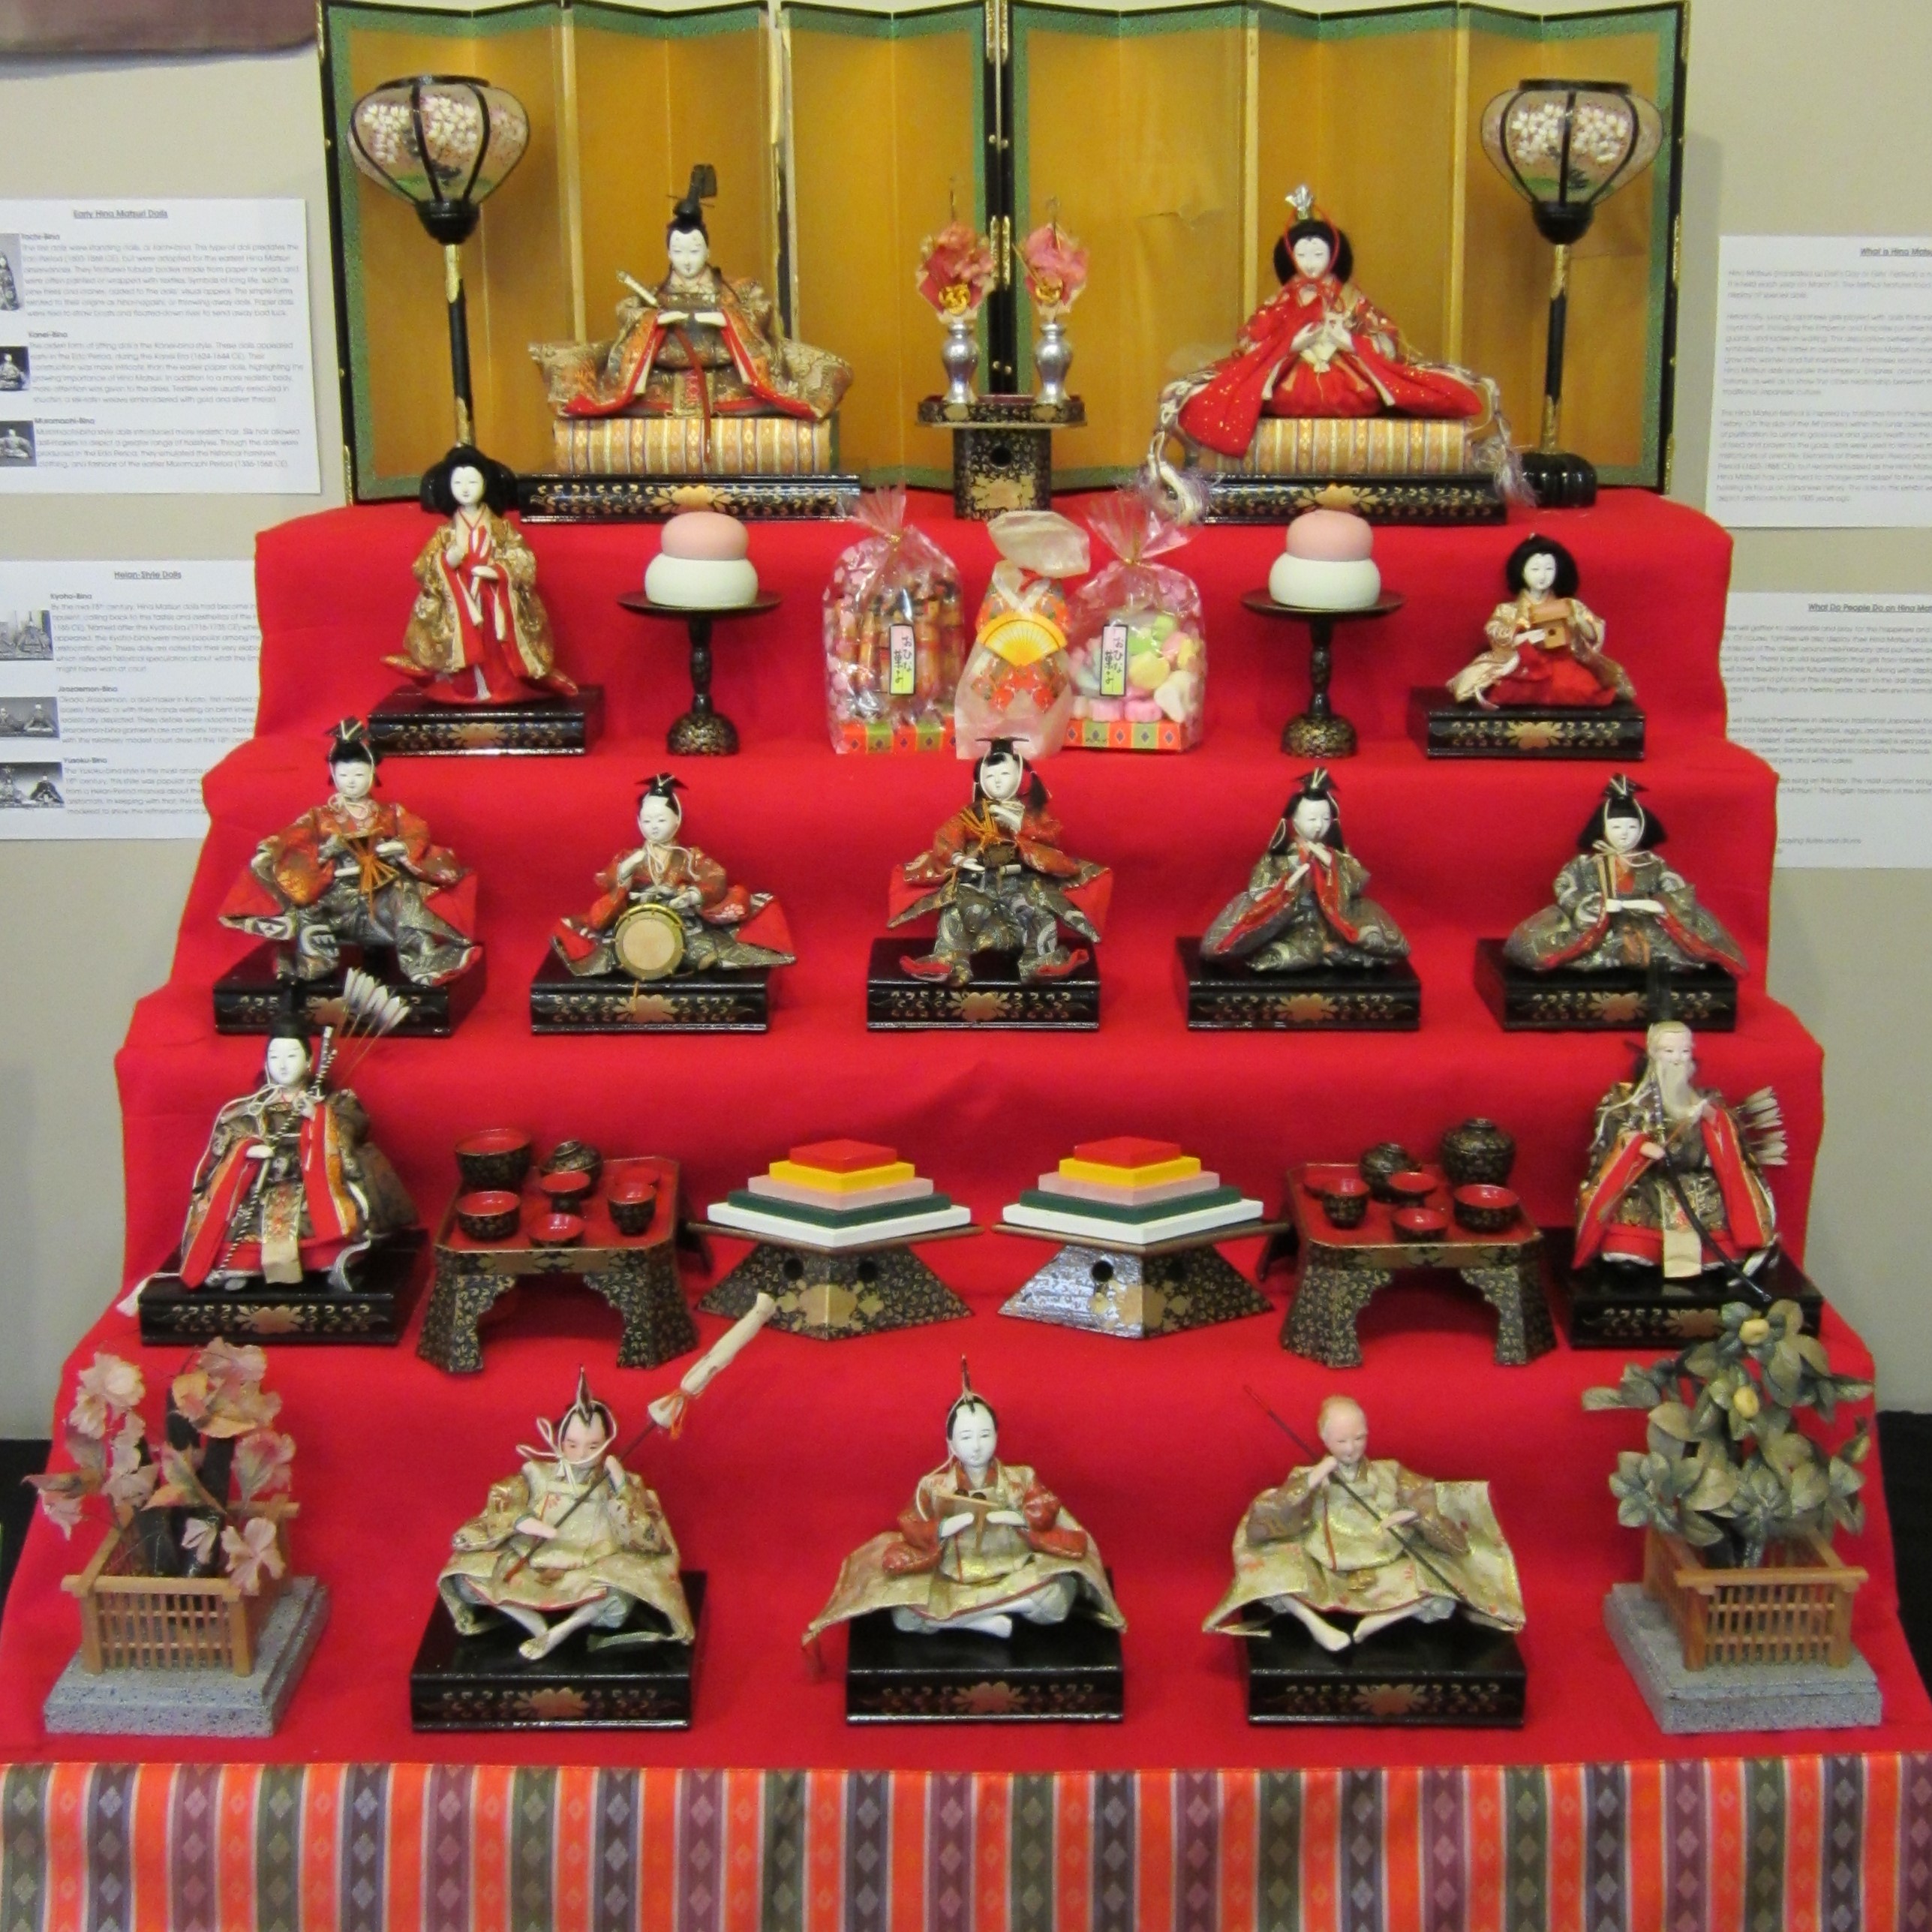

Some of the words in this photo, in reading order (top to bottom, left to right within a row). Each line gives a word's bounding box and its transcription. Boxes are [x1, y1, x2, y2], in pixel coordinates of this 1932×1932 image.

[95, 210, 114, 219] Hina
[116, 210, 146, 219] Matsuri
[115, 571, 159, 579] Heian-Style
[162, 571, 182, 579] Dolls
[1808, 604, 1828, 612] What
[1831, 604, 1841, 612] Do
[1843, 604, 1870, 612] People
[1873, 604, 1883, 612] Do
[1885, 604, 1895, 612] on
[1898, 604, 1915, 612] Hina
